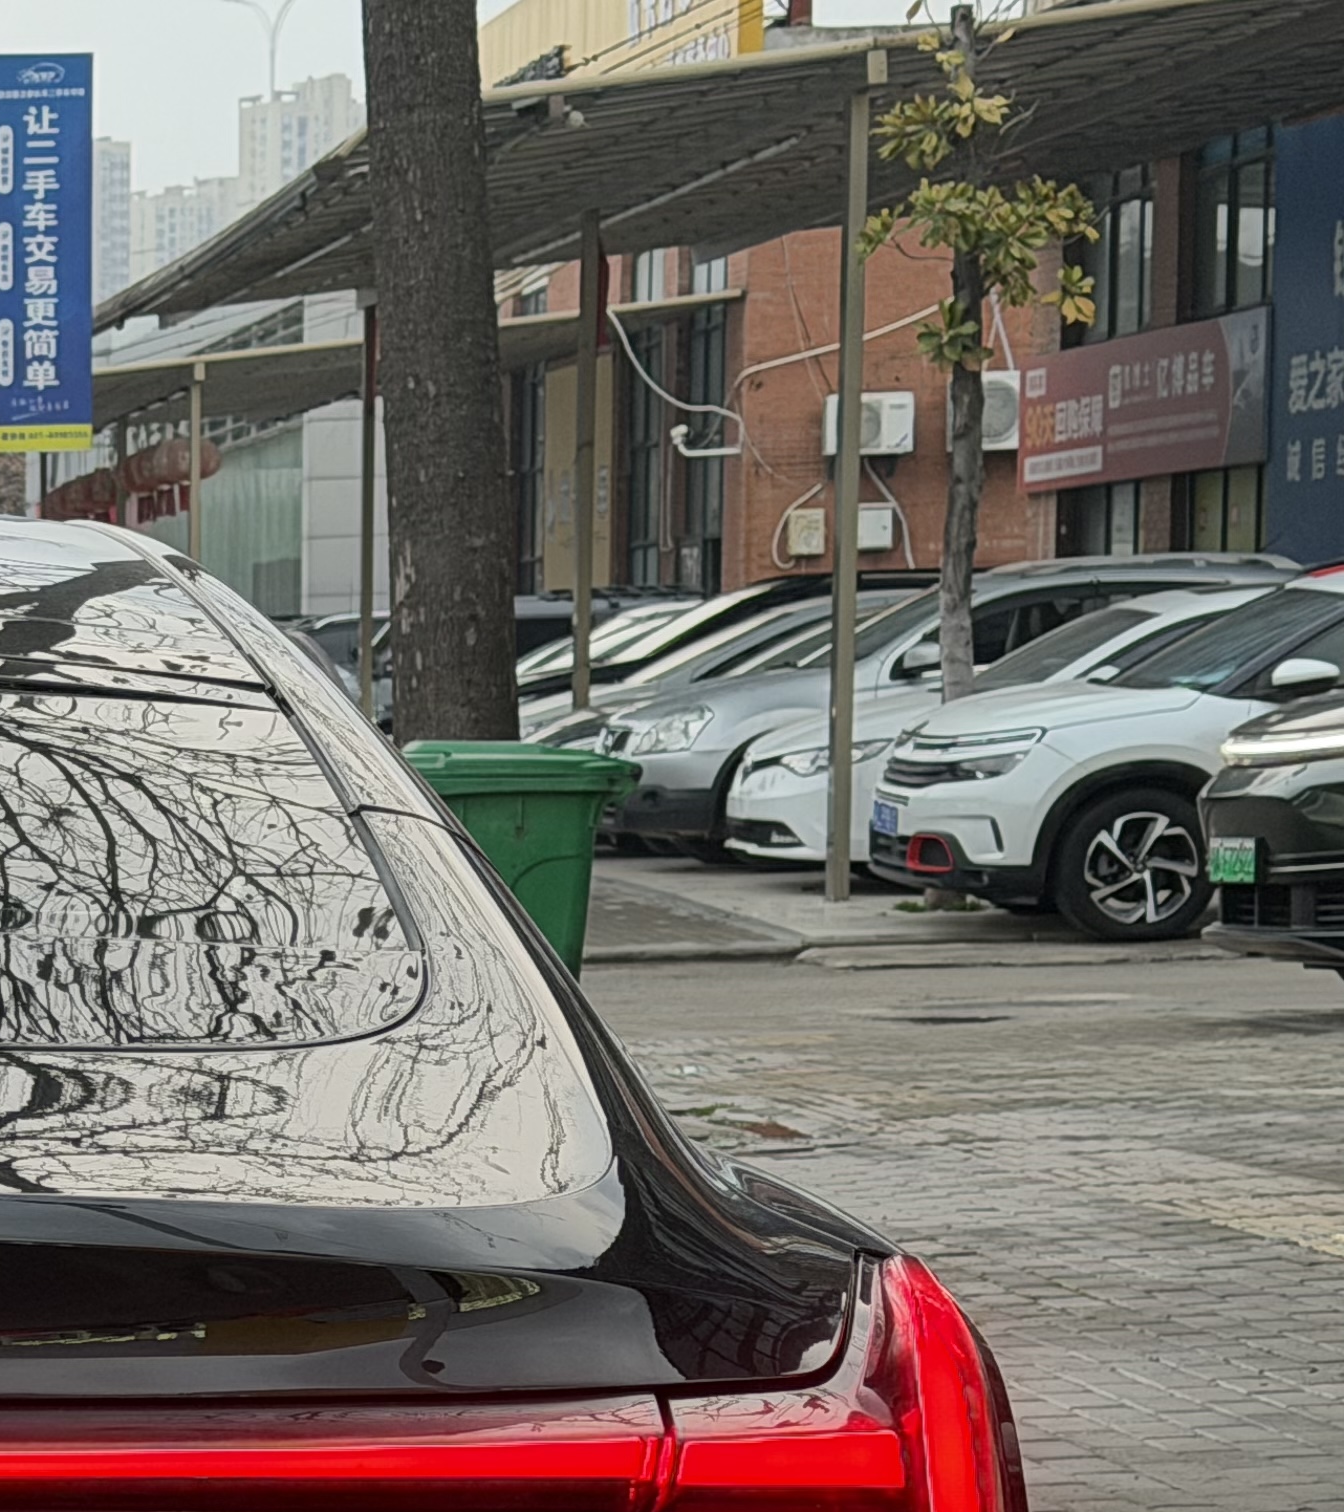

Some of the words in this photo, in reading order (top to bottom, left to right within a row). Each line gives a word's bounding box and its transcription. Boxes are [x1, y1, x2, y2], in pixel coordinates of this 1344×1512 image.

[21, 105, 61, 391] 让二手车交易更简单
